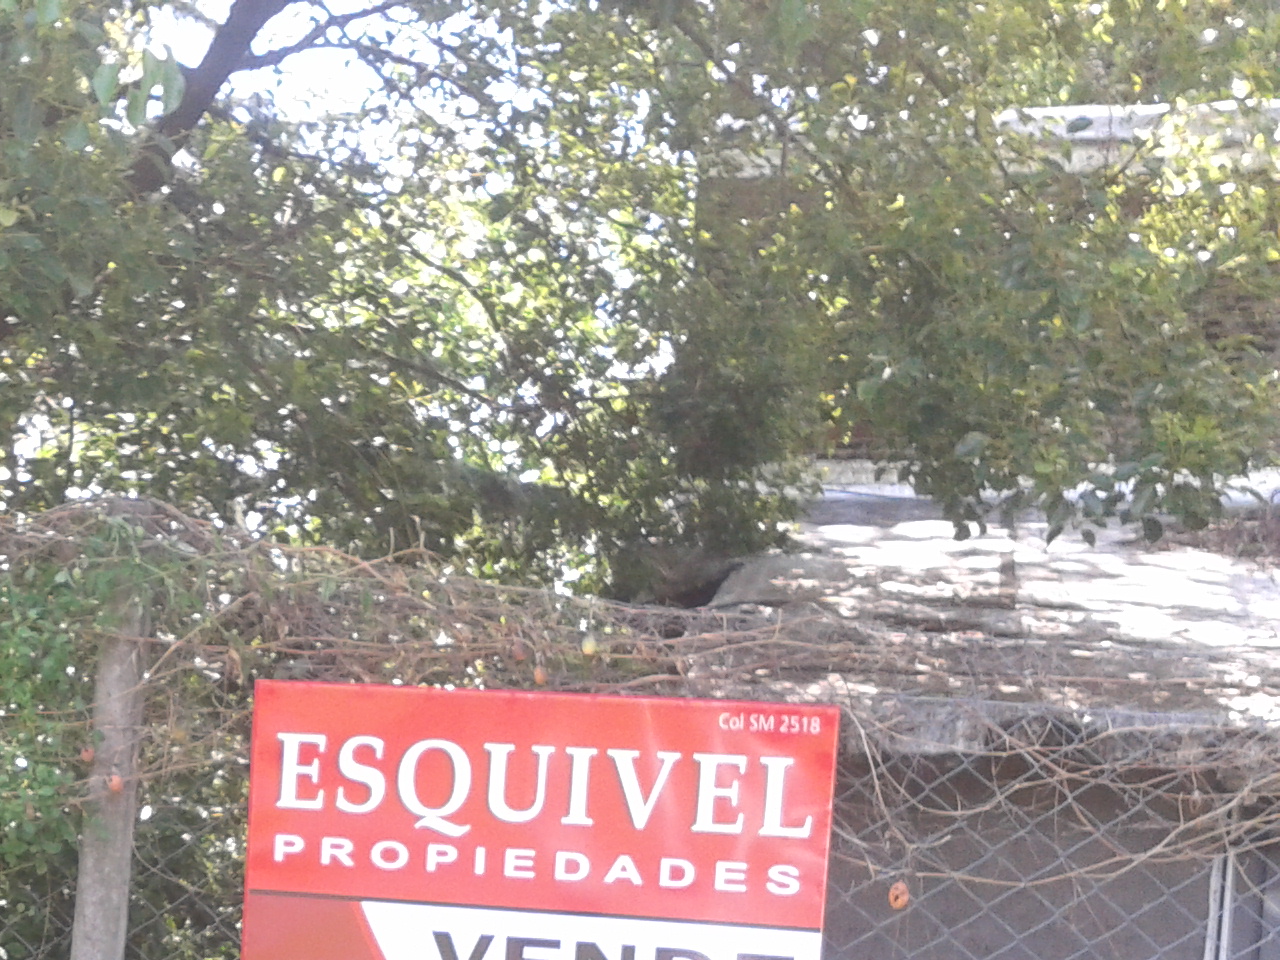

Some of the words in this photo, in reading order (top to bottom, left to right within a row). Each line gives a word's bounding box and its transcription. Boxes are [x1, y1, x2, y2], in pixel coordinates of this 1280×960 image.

[718, 711, 745, 731] Col
[749, 713, 775, 733] SM
[779, 714, 821, 735] 2518
[274, 731, 814, 839] ESQUIVEL
[272, 834, 802, 896] PROPIEDADES
